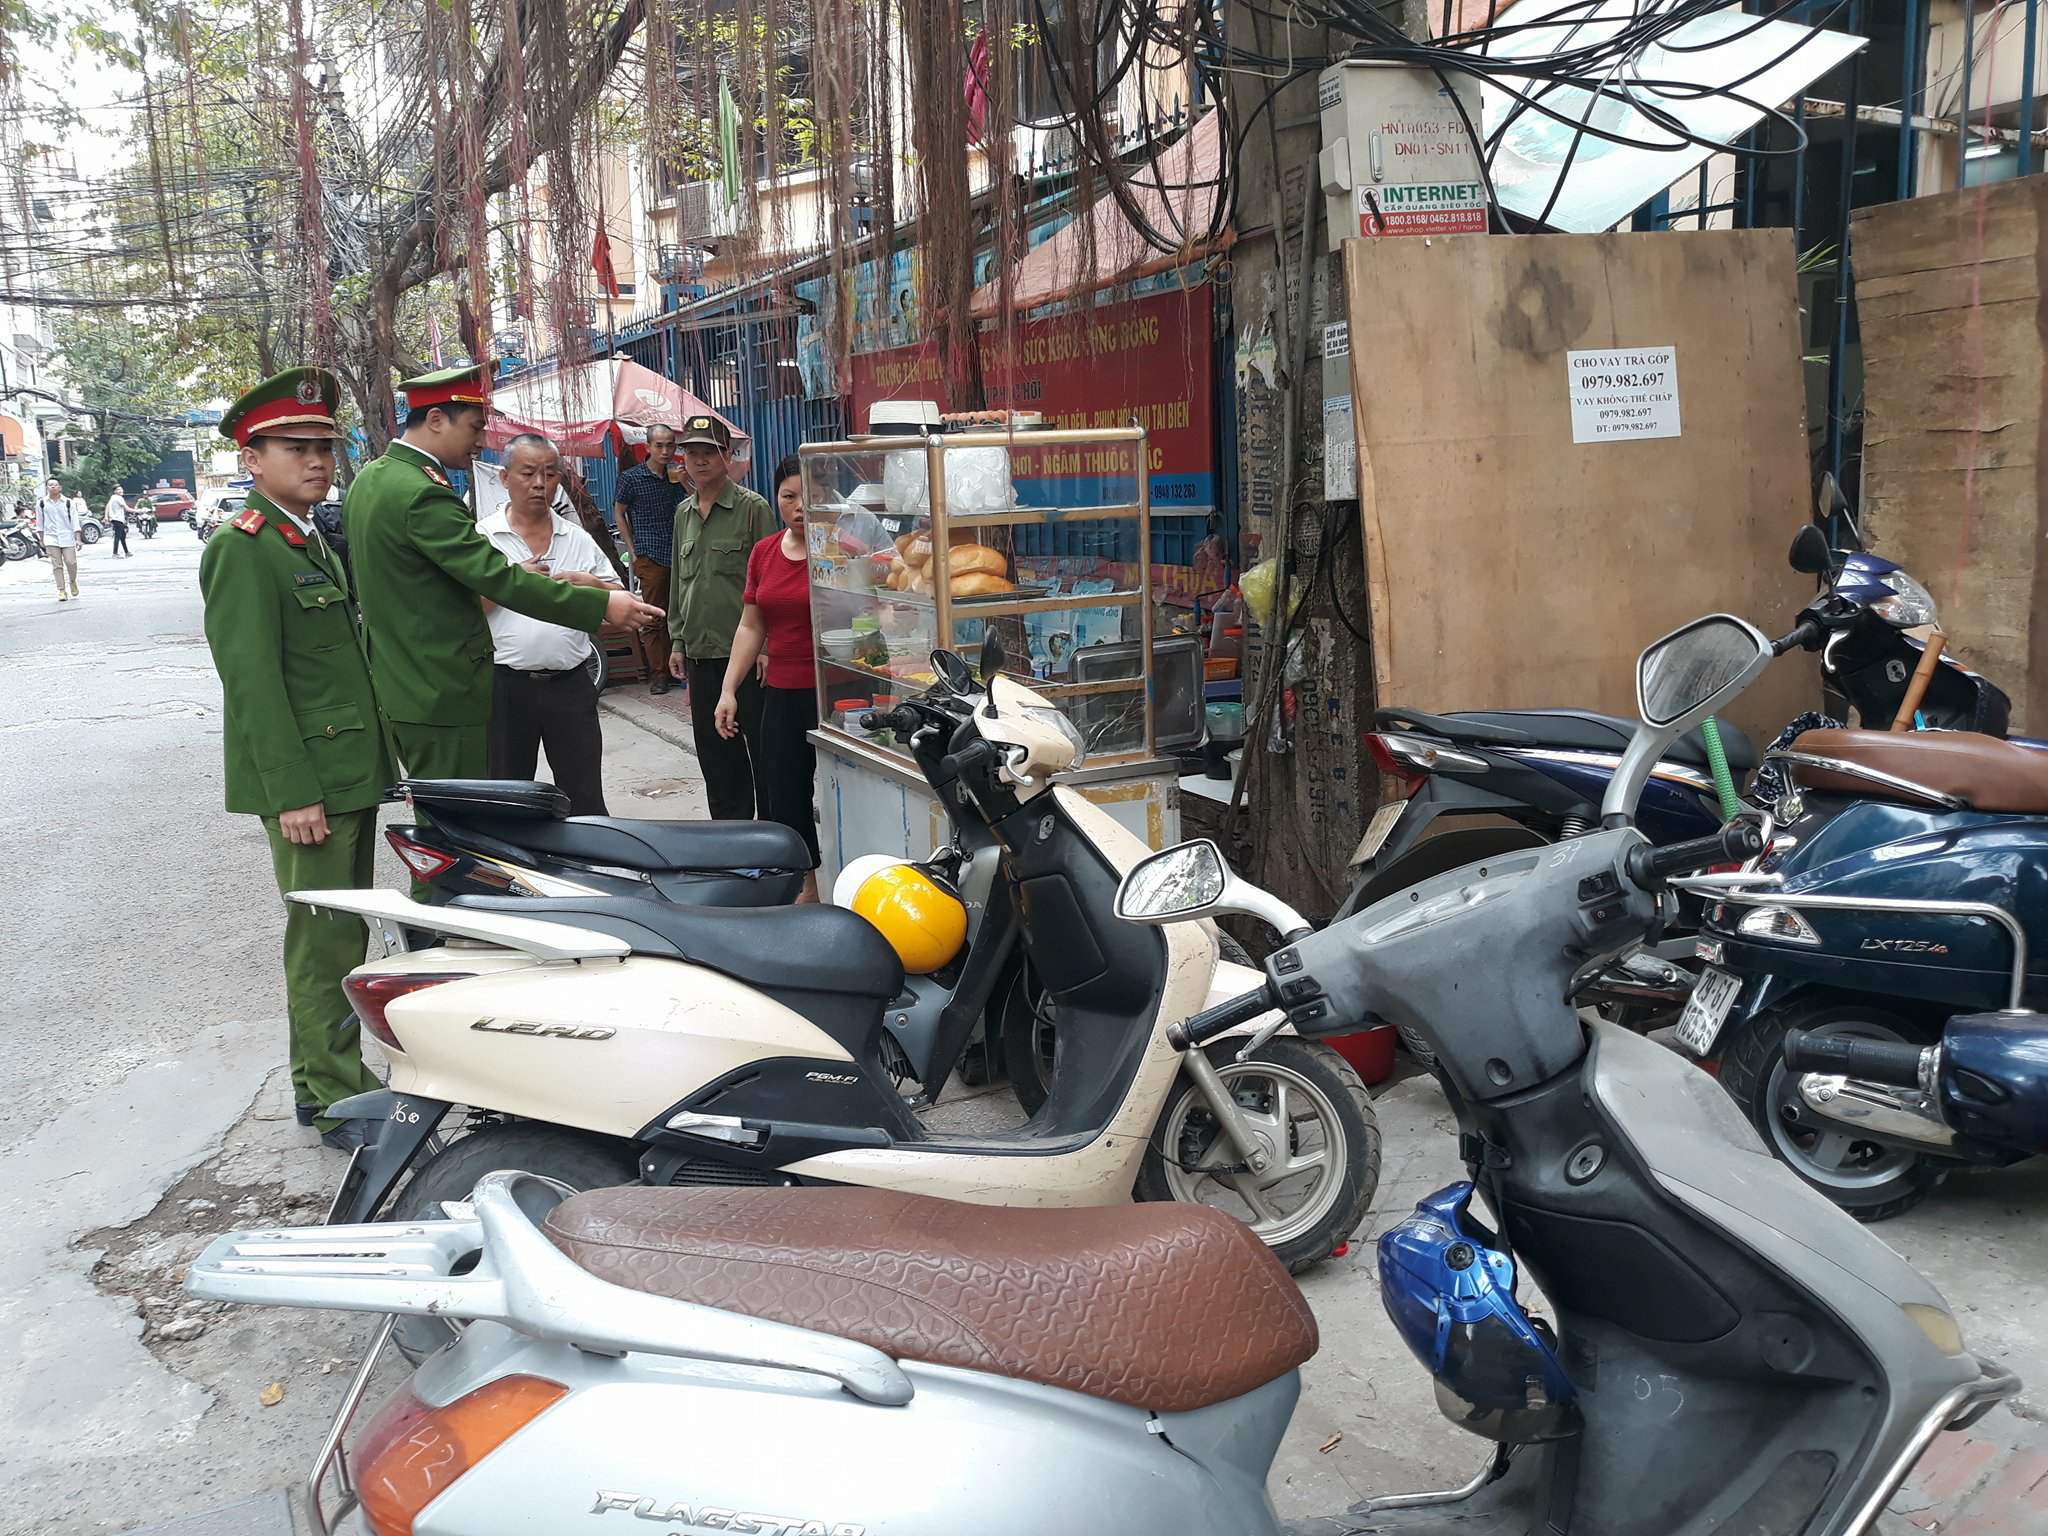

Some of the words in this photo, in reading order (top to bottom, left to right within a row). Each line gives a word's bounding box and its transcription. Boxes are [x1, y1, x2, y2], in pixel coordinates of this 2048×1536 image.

[1383, 184, 1479, 203] INTERNET
[1405, 203, 1438, 211] QUANG
[1573, 357, 1598, 369] CHO
[1599, 356, 1622, 367] VAY
[1581, 372, 1665, 389] 0979.982.697
[1576, 397, 1595, 407] VAY
[1596, 393, 1629, 406] KHÔNG
[1152, 403, 1166, 430] TAI
[1599, 407, 1652, 419] 0979.982.697
[1612, 422, 1657, 432] 0979.982.697
[1043, 450, 1081, 475] NGÂM
[470, 1015, 617, 1041] LEAD
